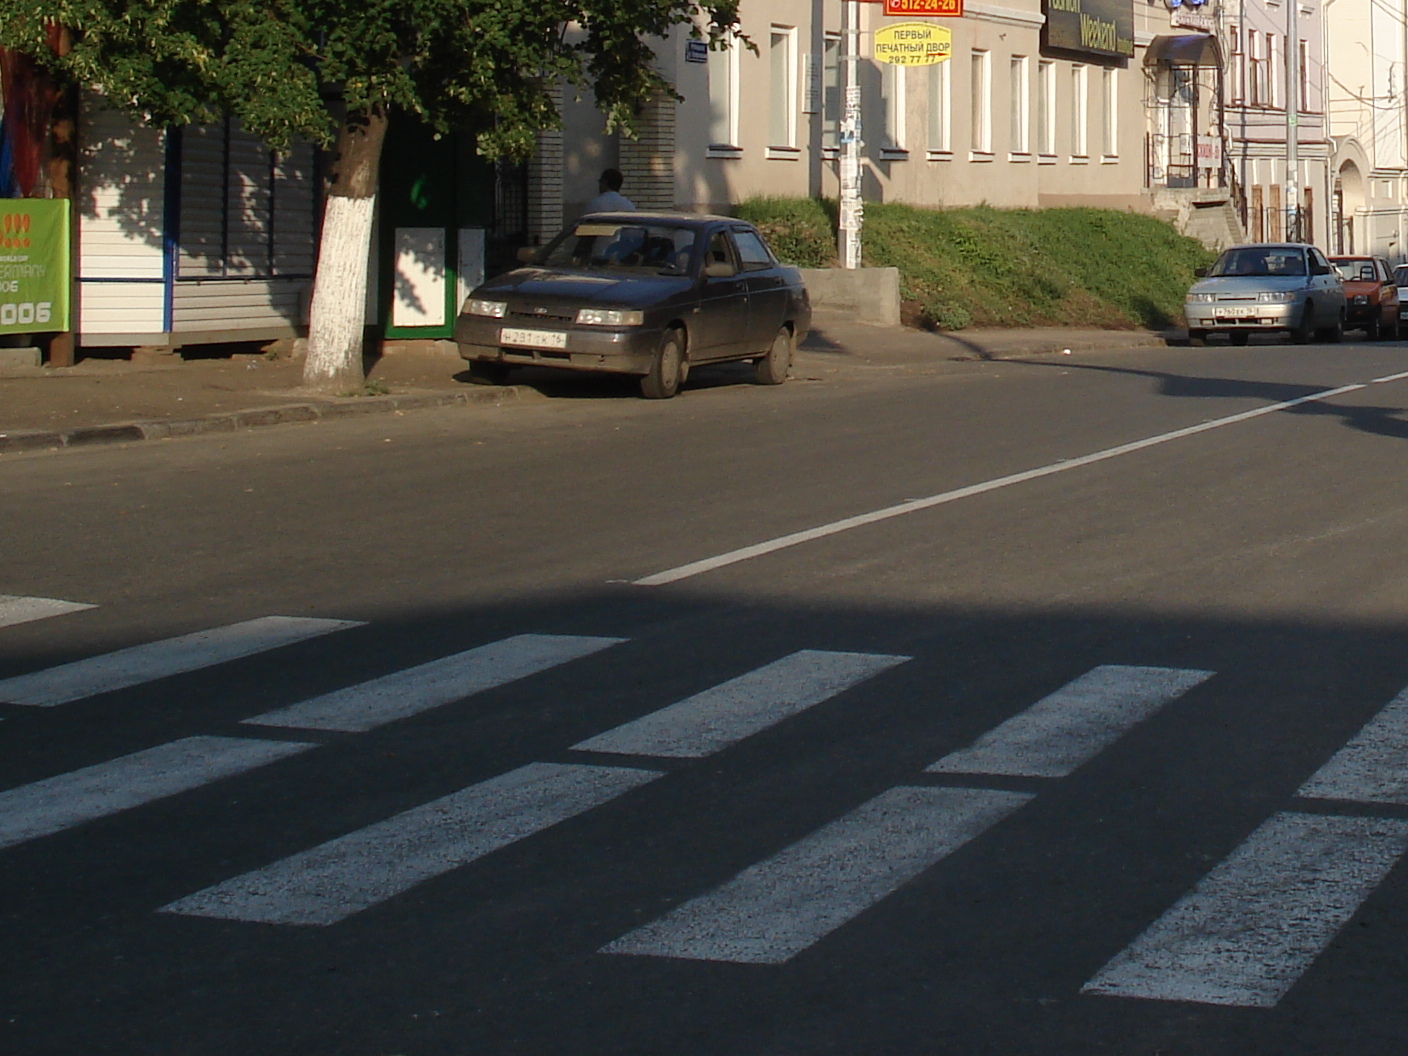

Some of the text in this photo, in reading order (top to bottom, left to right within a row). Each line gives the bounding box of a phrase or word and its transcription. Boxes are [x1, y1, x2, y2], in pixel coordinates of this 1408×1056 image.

[893, 28, 932, 40] ПЕРВЫЙ
[876, 41, 951, 53] ПЕЧАТНЫЙ ДВОР
